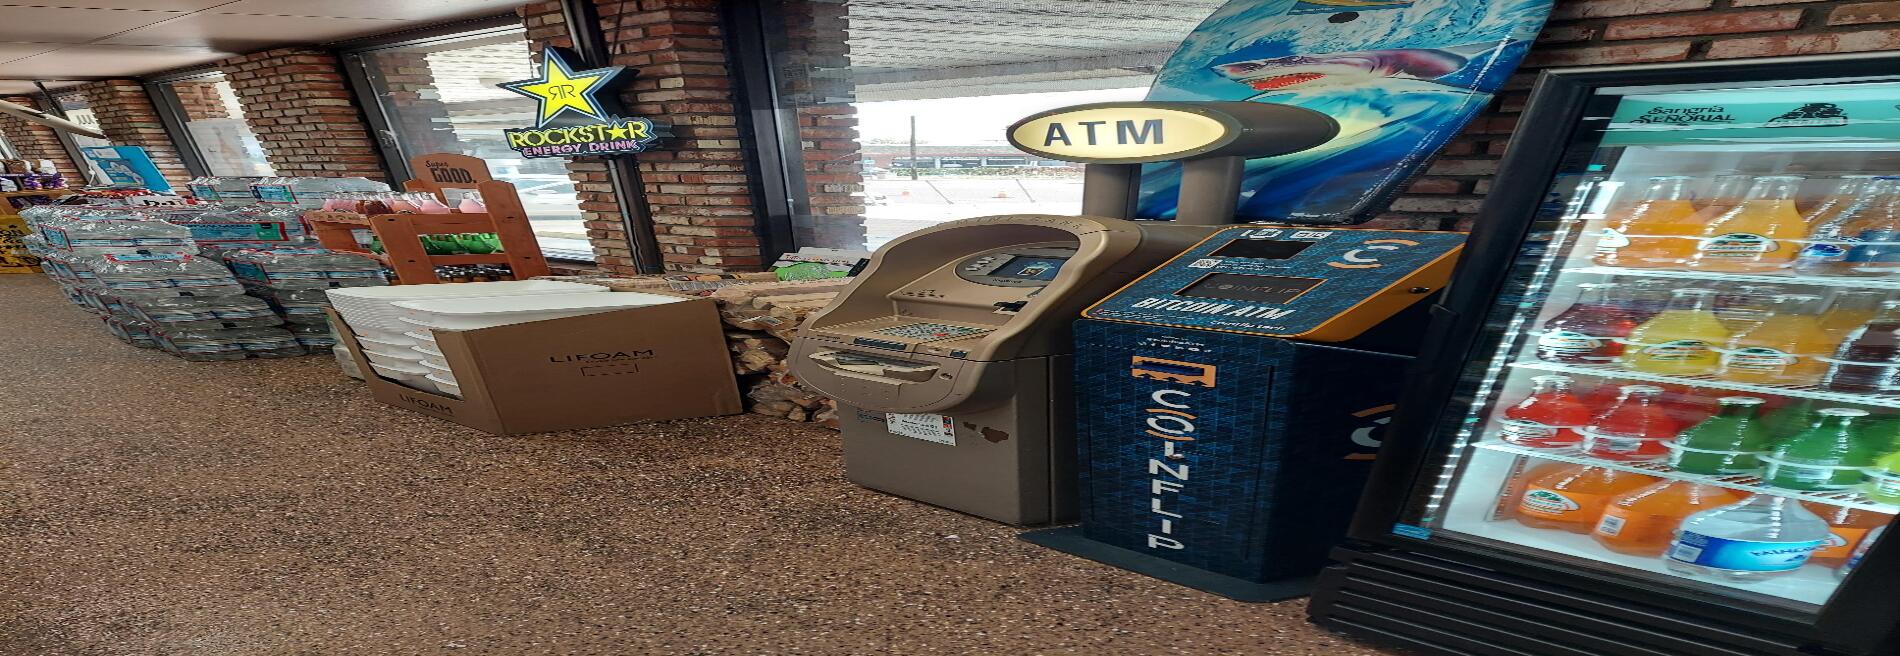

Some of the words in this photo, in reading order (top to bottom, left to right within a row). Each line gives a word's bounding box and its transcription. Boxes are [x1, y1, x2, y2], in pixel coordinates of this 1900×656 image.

[1043, 118, 1164, 147] ATM
[523, 143, 582, 156] ENERGY
[588, 140, 637, 152] DRINK
[426, 160, 449, 170] Super
[1131, 297, 1236, 315] BITCOIN
[1222, 305, 1297, 320] ATM
[550, 349, 654, 363] LIFOAM
[400, 393, 453, 414] LIFOAM
[1145, 390, 1198, 552] COINFLIP
